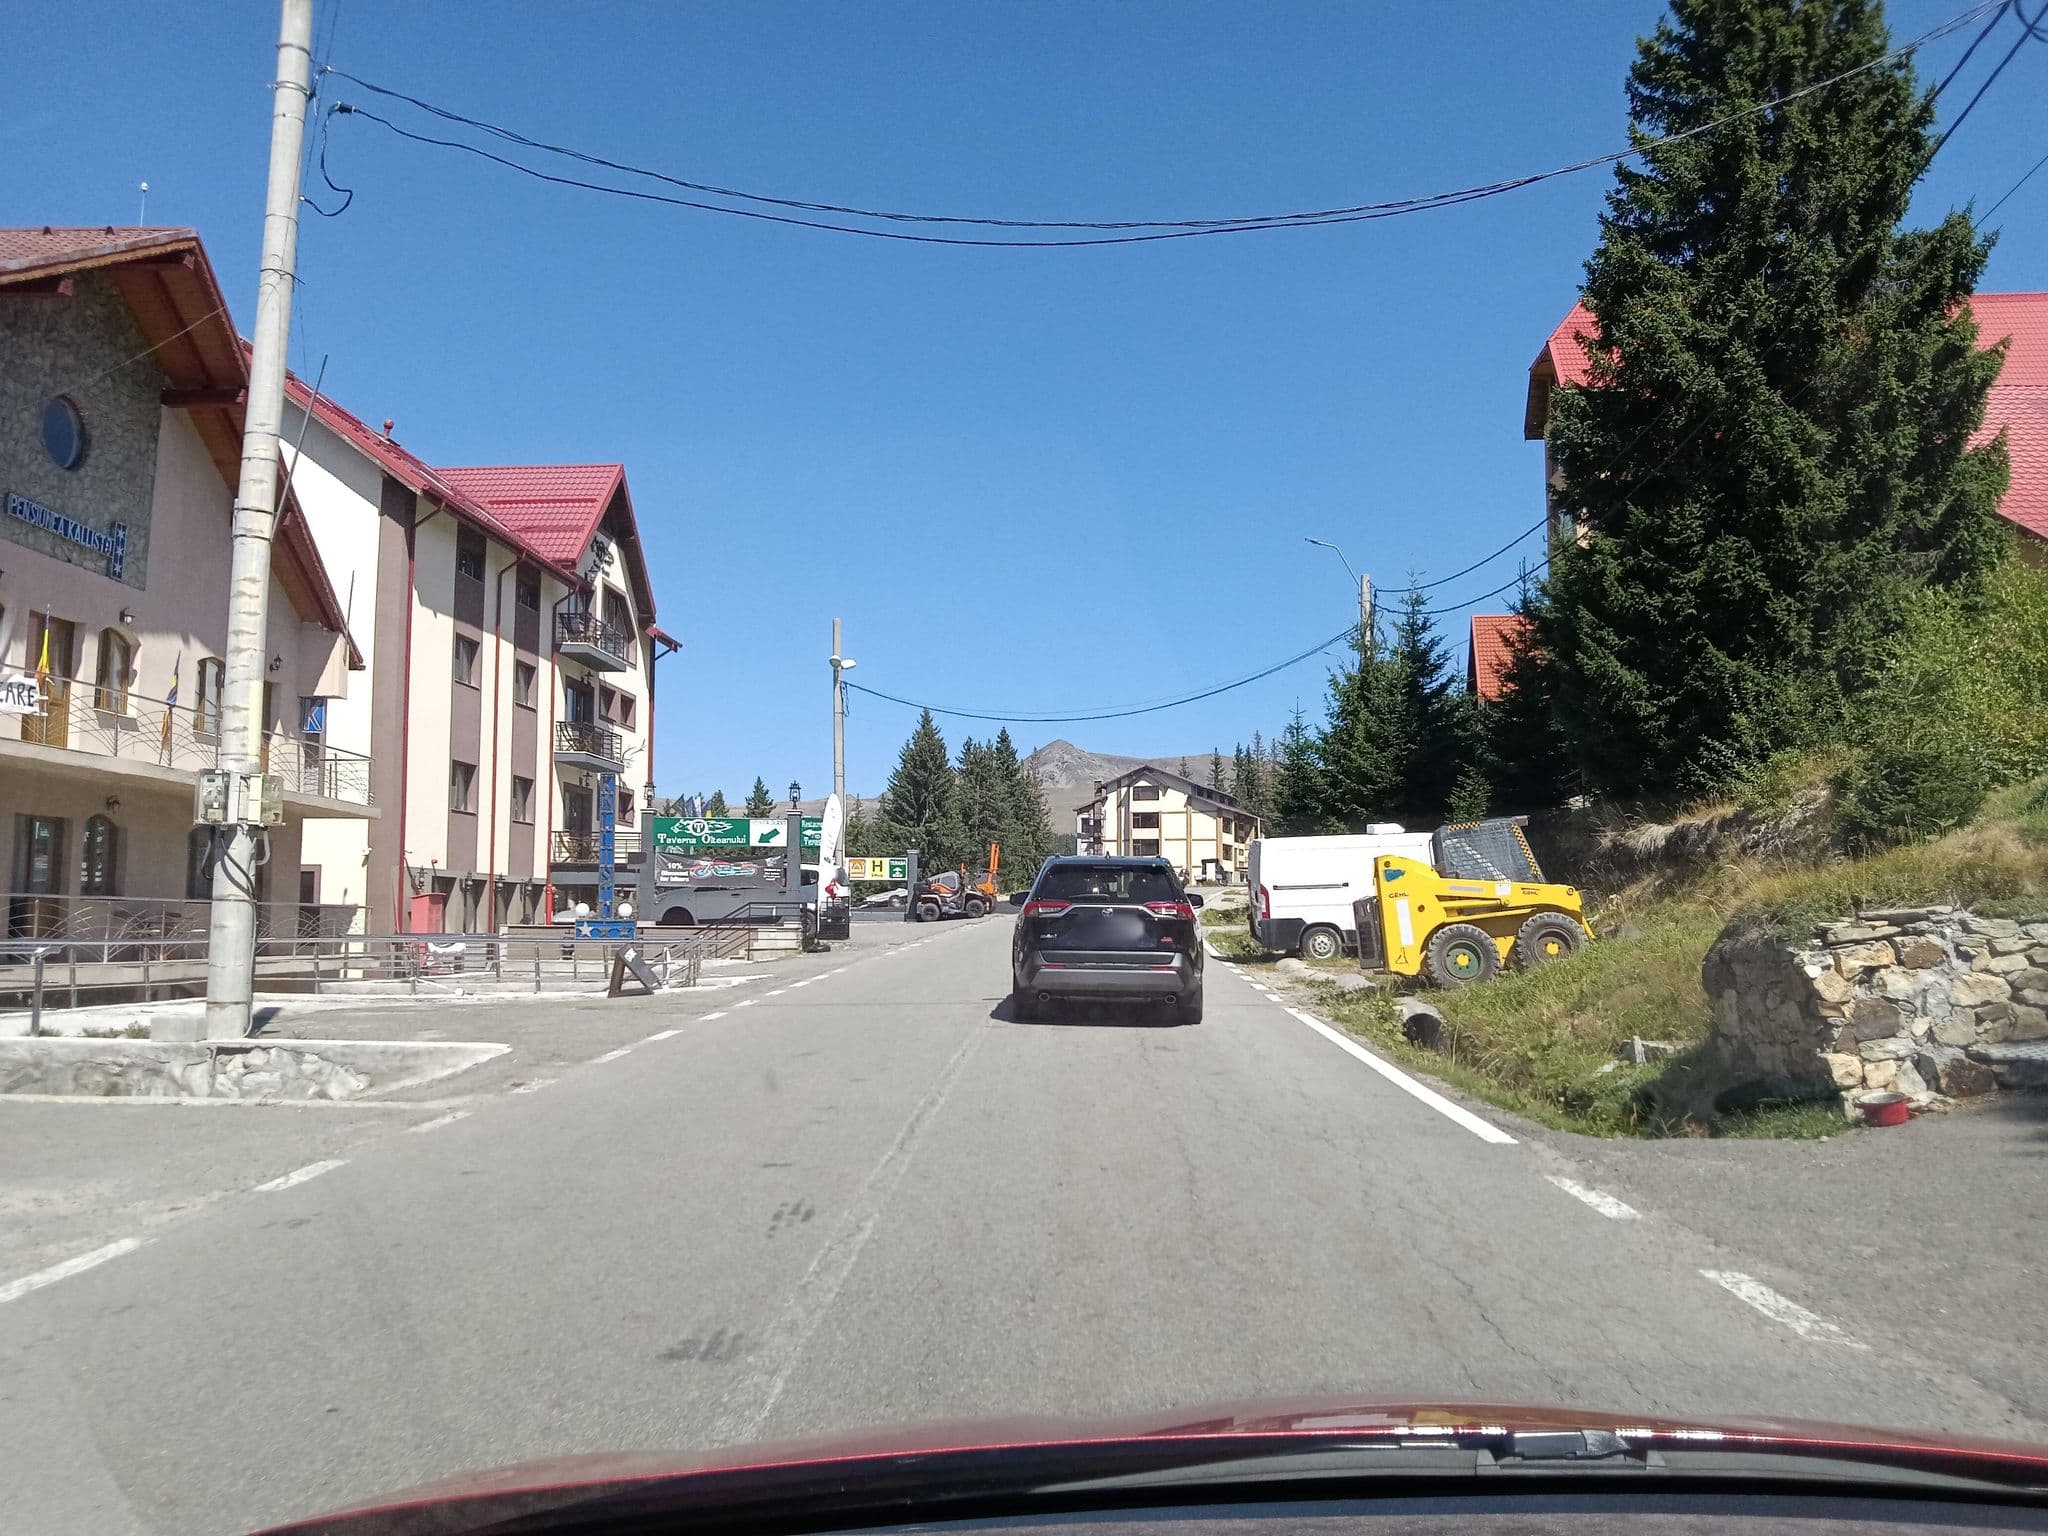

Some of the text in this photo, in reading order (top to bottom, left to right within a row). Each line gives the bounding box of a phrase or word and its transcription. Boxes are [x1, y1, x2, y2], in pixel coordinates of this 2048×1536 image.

[10, 495, 65, 536] PENSIUNEA
[657, 833, 747, 844] Taverna Okeanului
[667, 862, 683, 870] 10%
[872, 859, 883, 873] H
